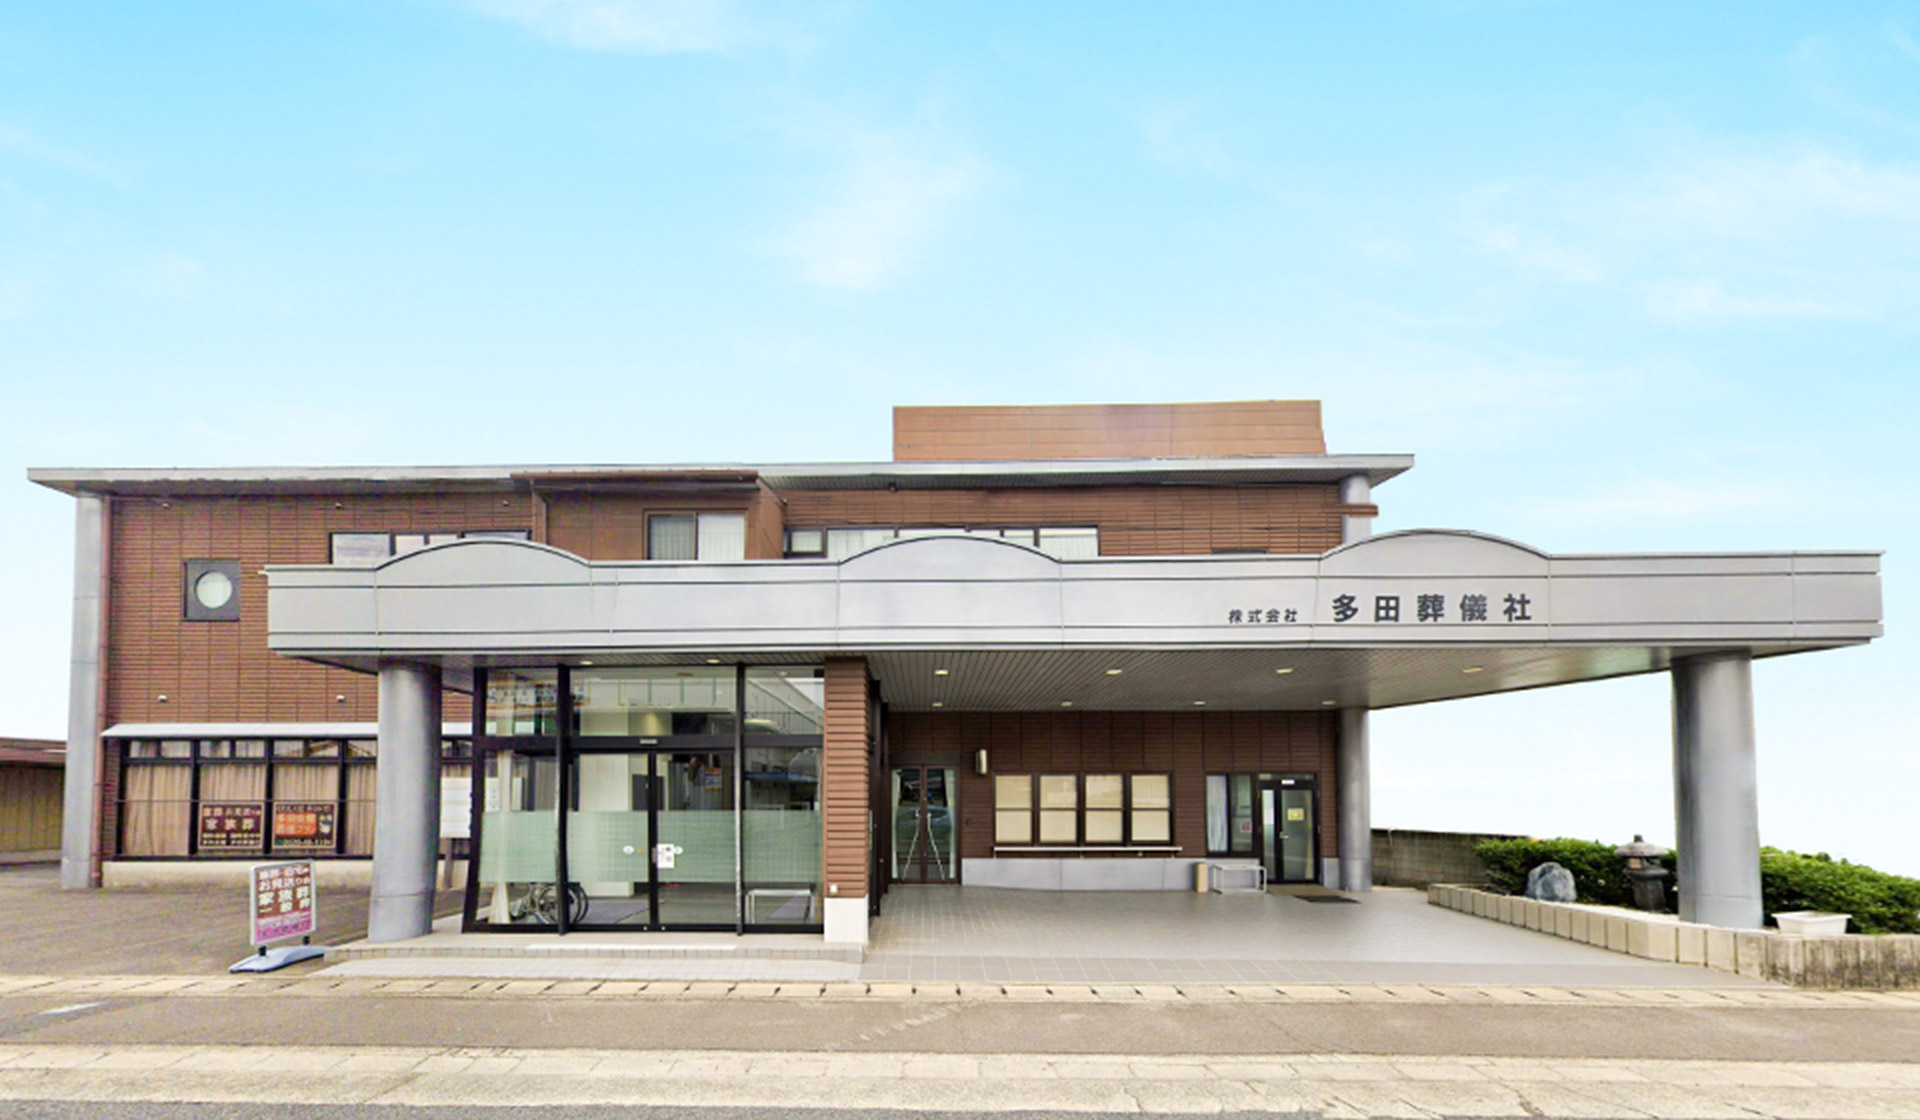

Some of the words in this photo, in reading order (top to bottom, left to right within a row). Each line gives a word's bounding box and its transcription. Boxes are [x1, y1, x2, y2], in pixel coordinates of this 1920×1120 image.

[1228, 608, 1298, 624] 株式会社
[1332, 593, 1532, 623] 多田葬儀社
